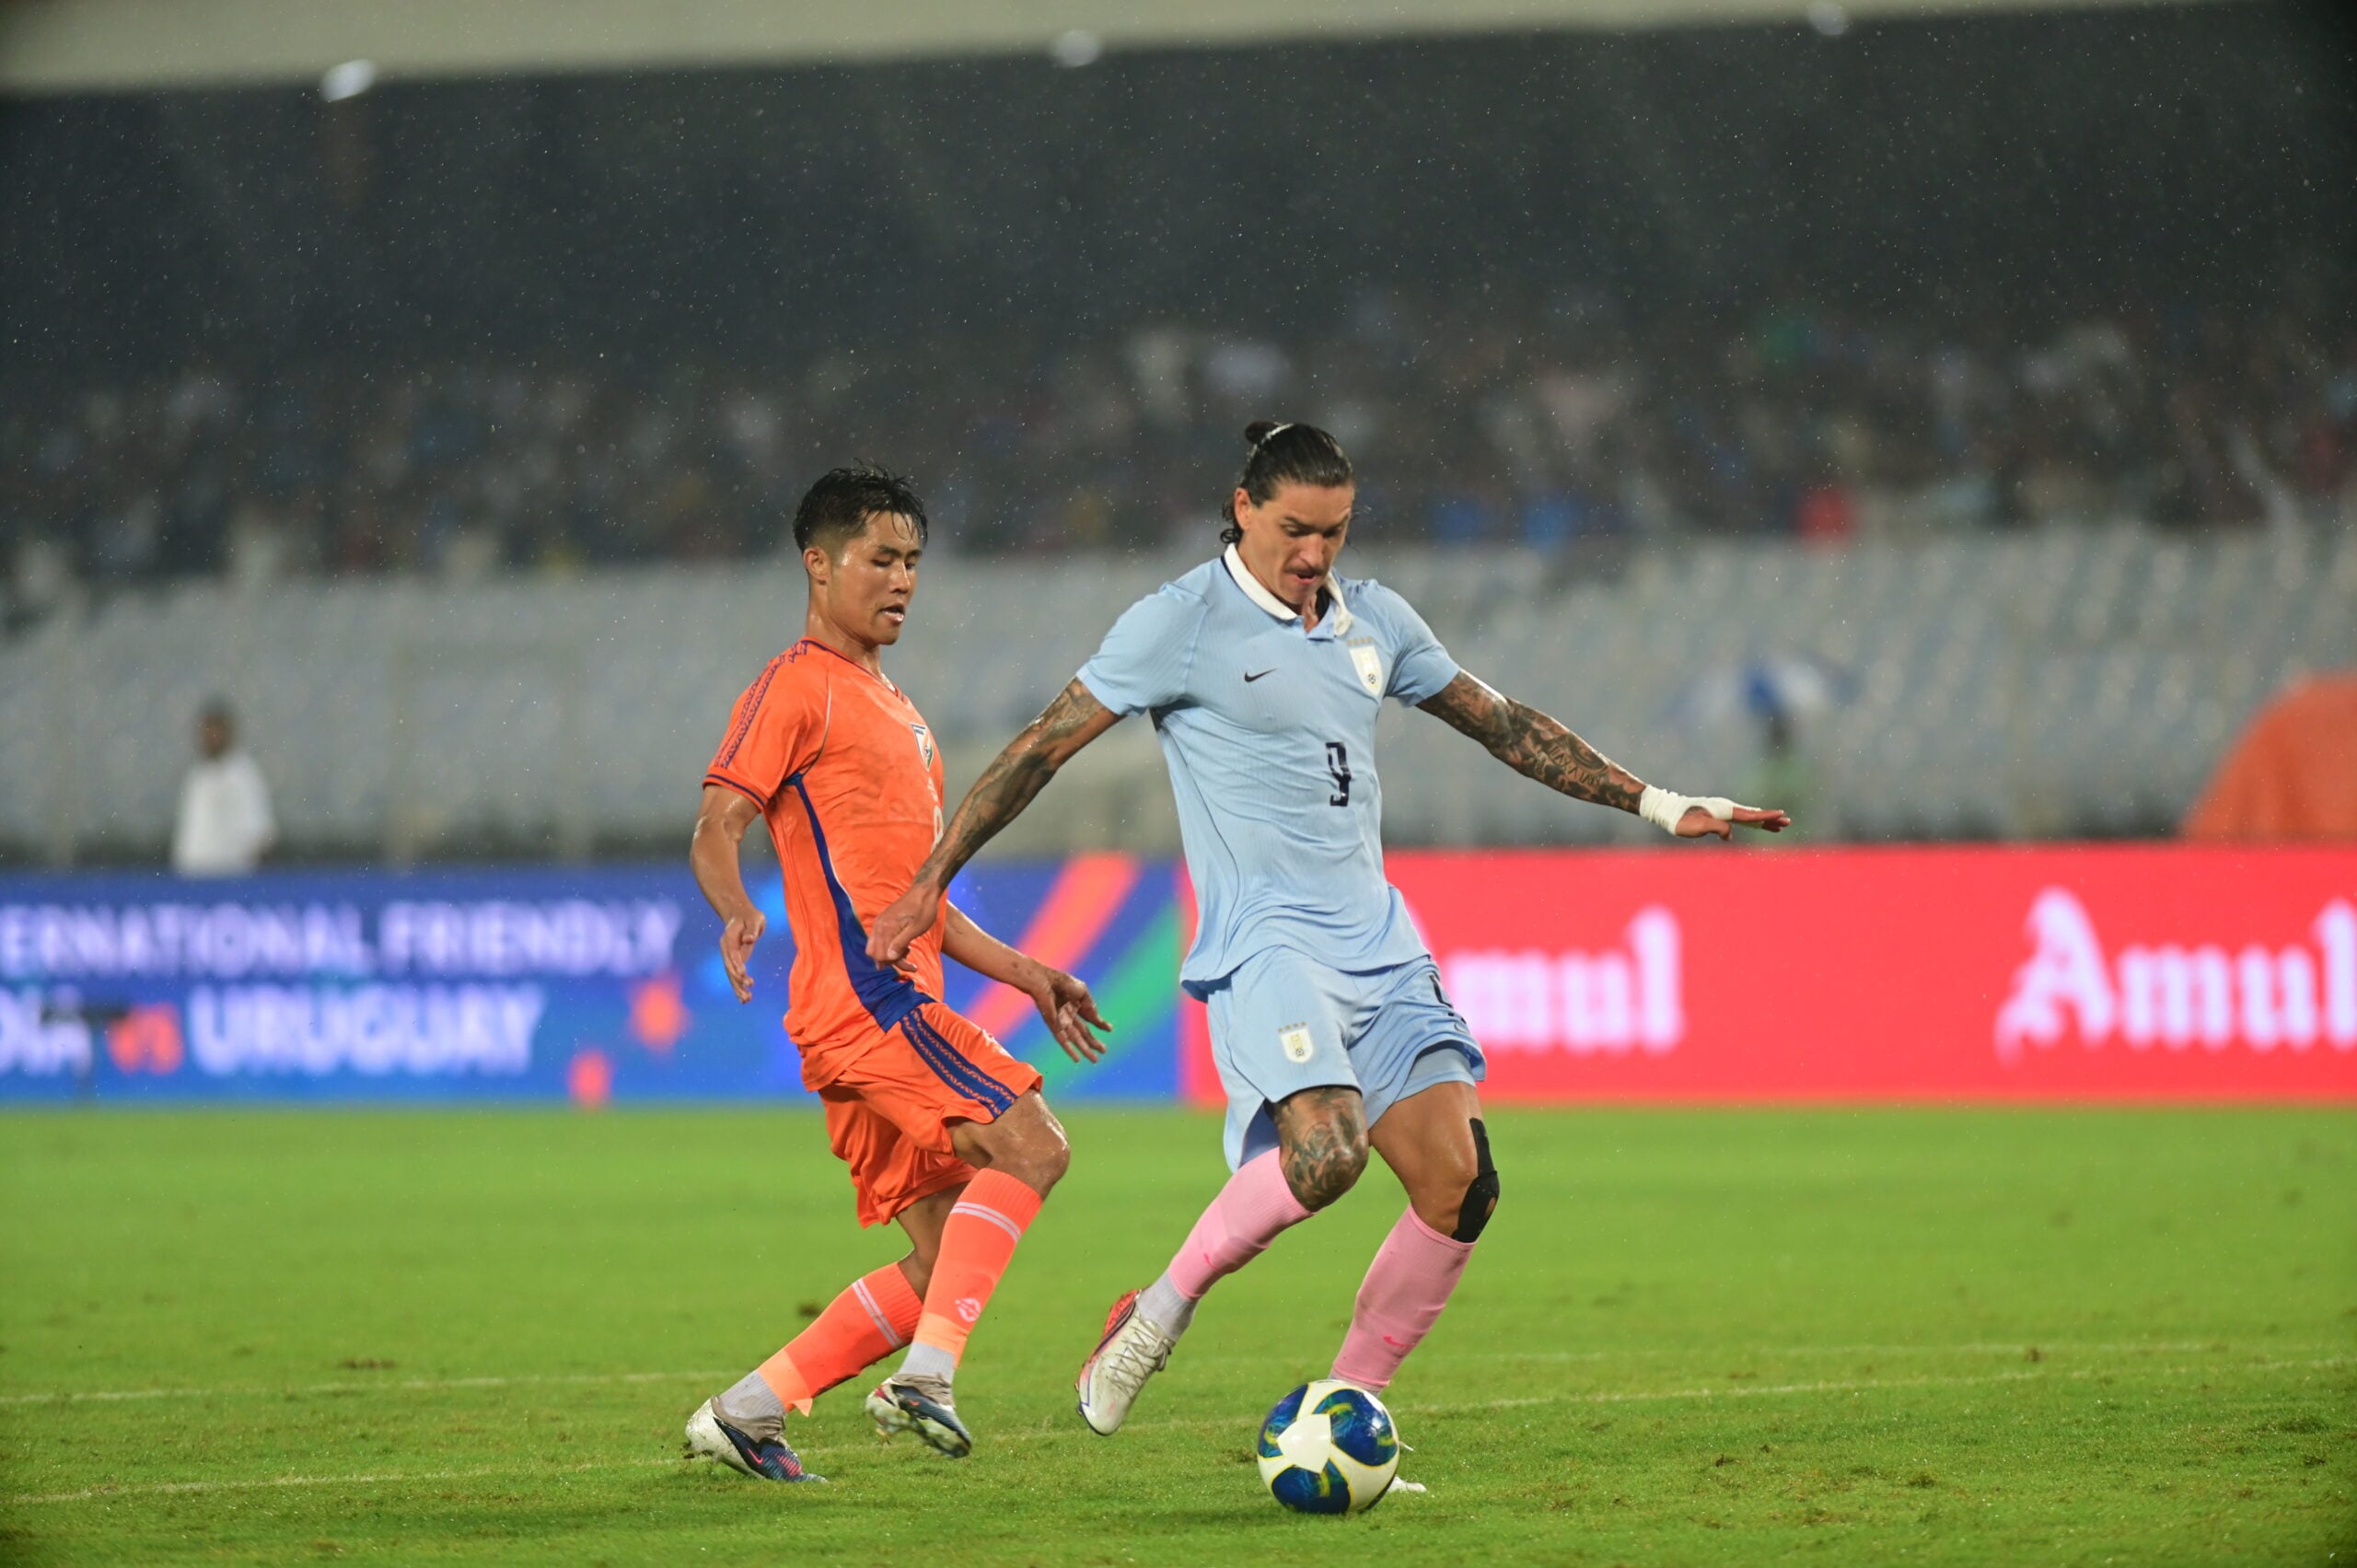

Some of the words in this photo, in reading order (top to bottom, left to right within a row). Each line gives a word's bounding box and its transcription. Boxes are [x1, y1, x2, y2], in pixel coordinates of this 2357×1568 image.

[1326, 741, 1352, 807] 9
[378, 901, 682, 977] FRIENDLY
[1411, 902, 1685, 1055] mul
[1995, 887, 2357, 1064] Amul
[188, 983, 545, 1075] URUGUAY
